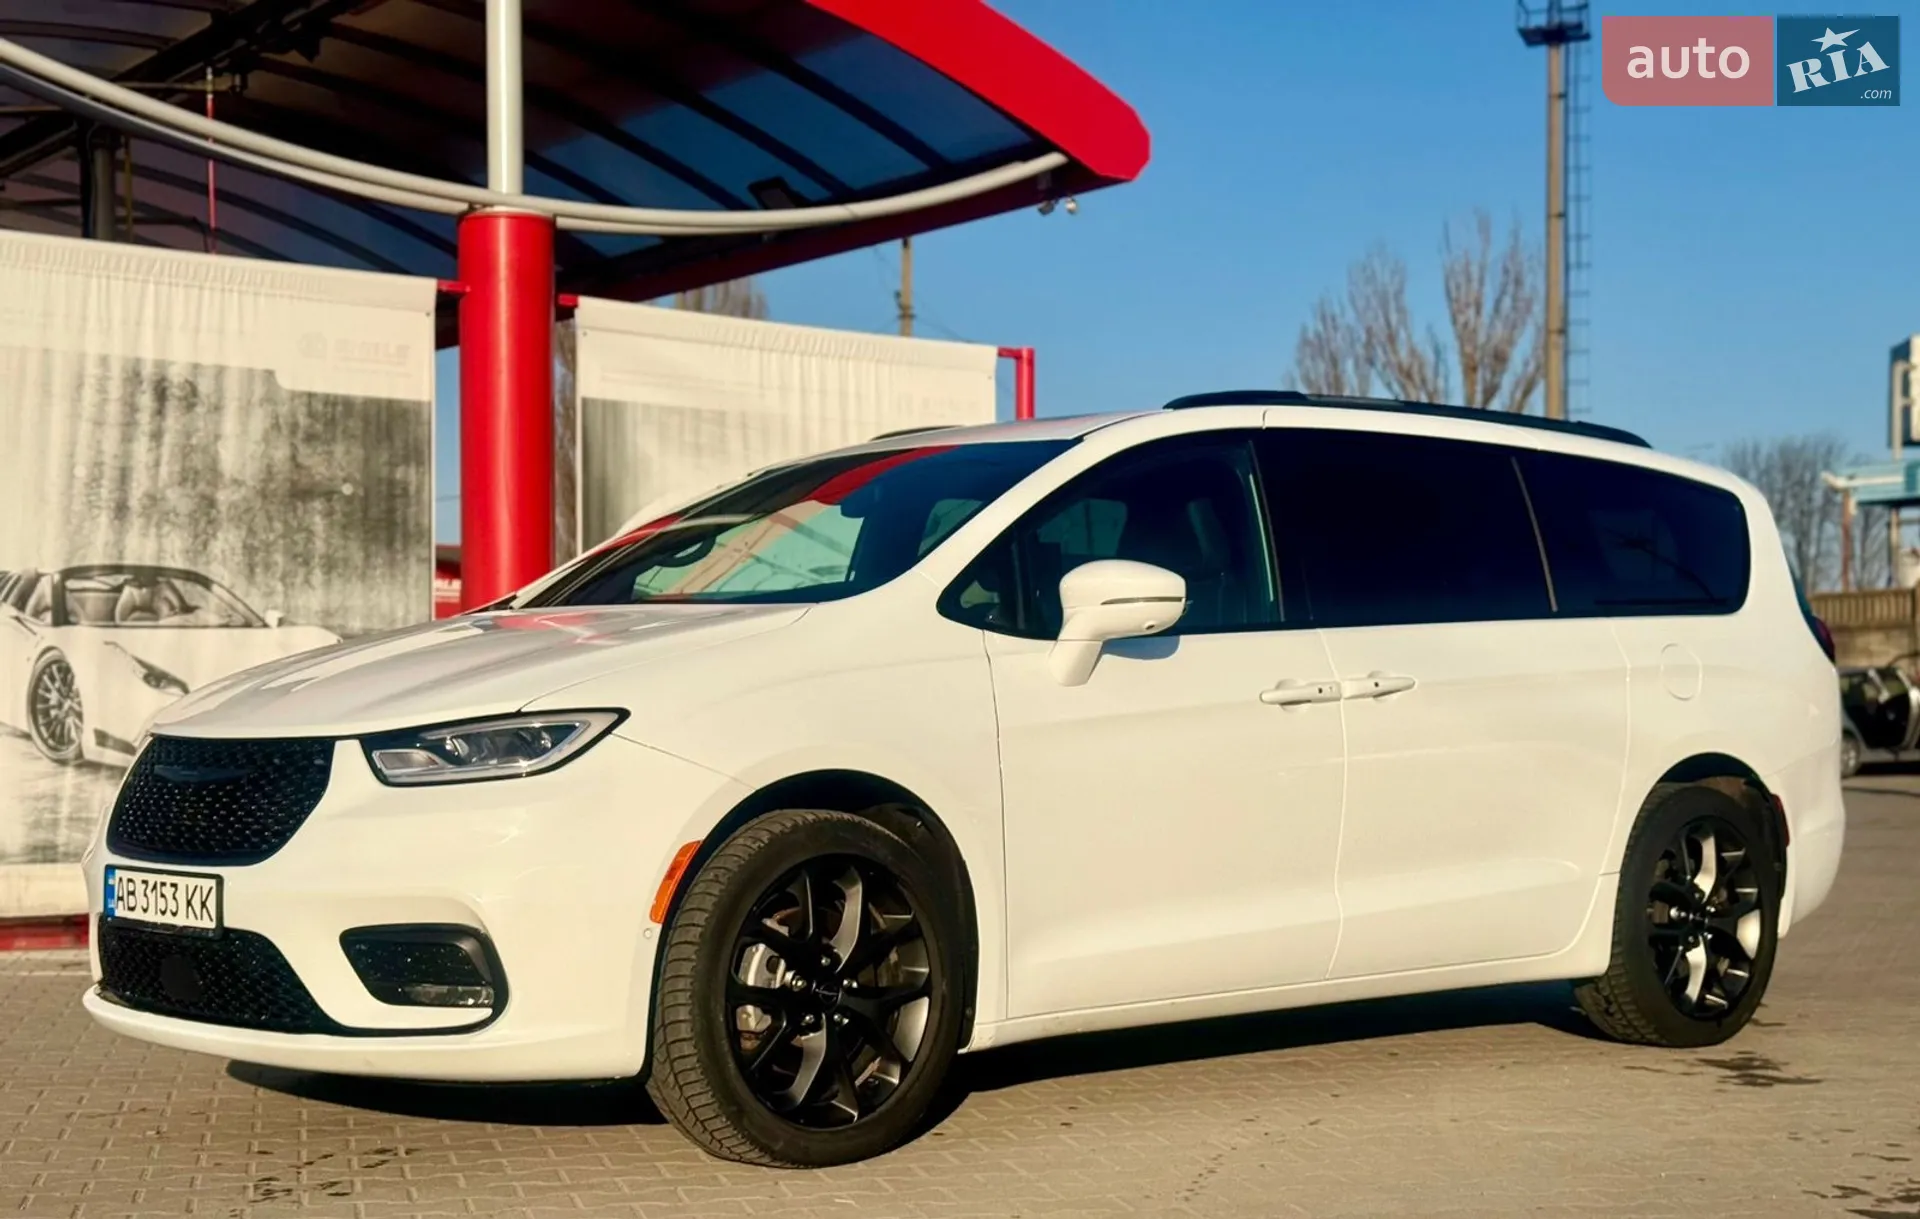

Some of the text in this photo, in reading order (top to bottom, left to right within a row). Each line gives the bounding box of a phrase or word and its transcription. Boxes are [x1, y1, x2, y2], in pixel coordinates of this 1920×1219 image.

[116, 876, 214, 922] AB 3153 KK
